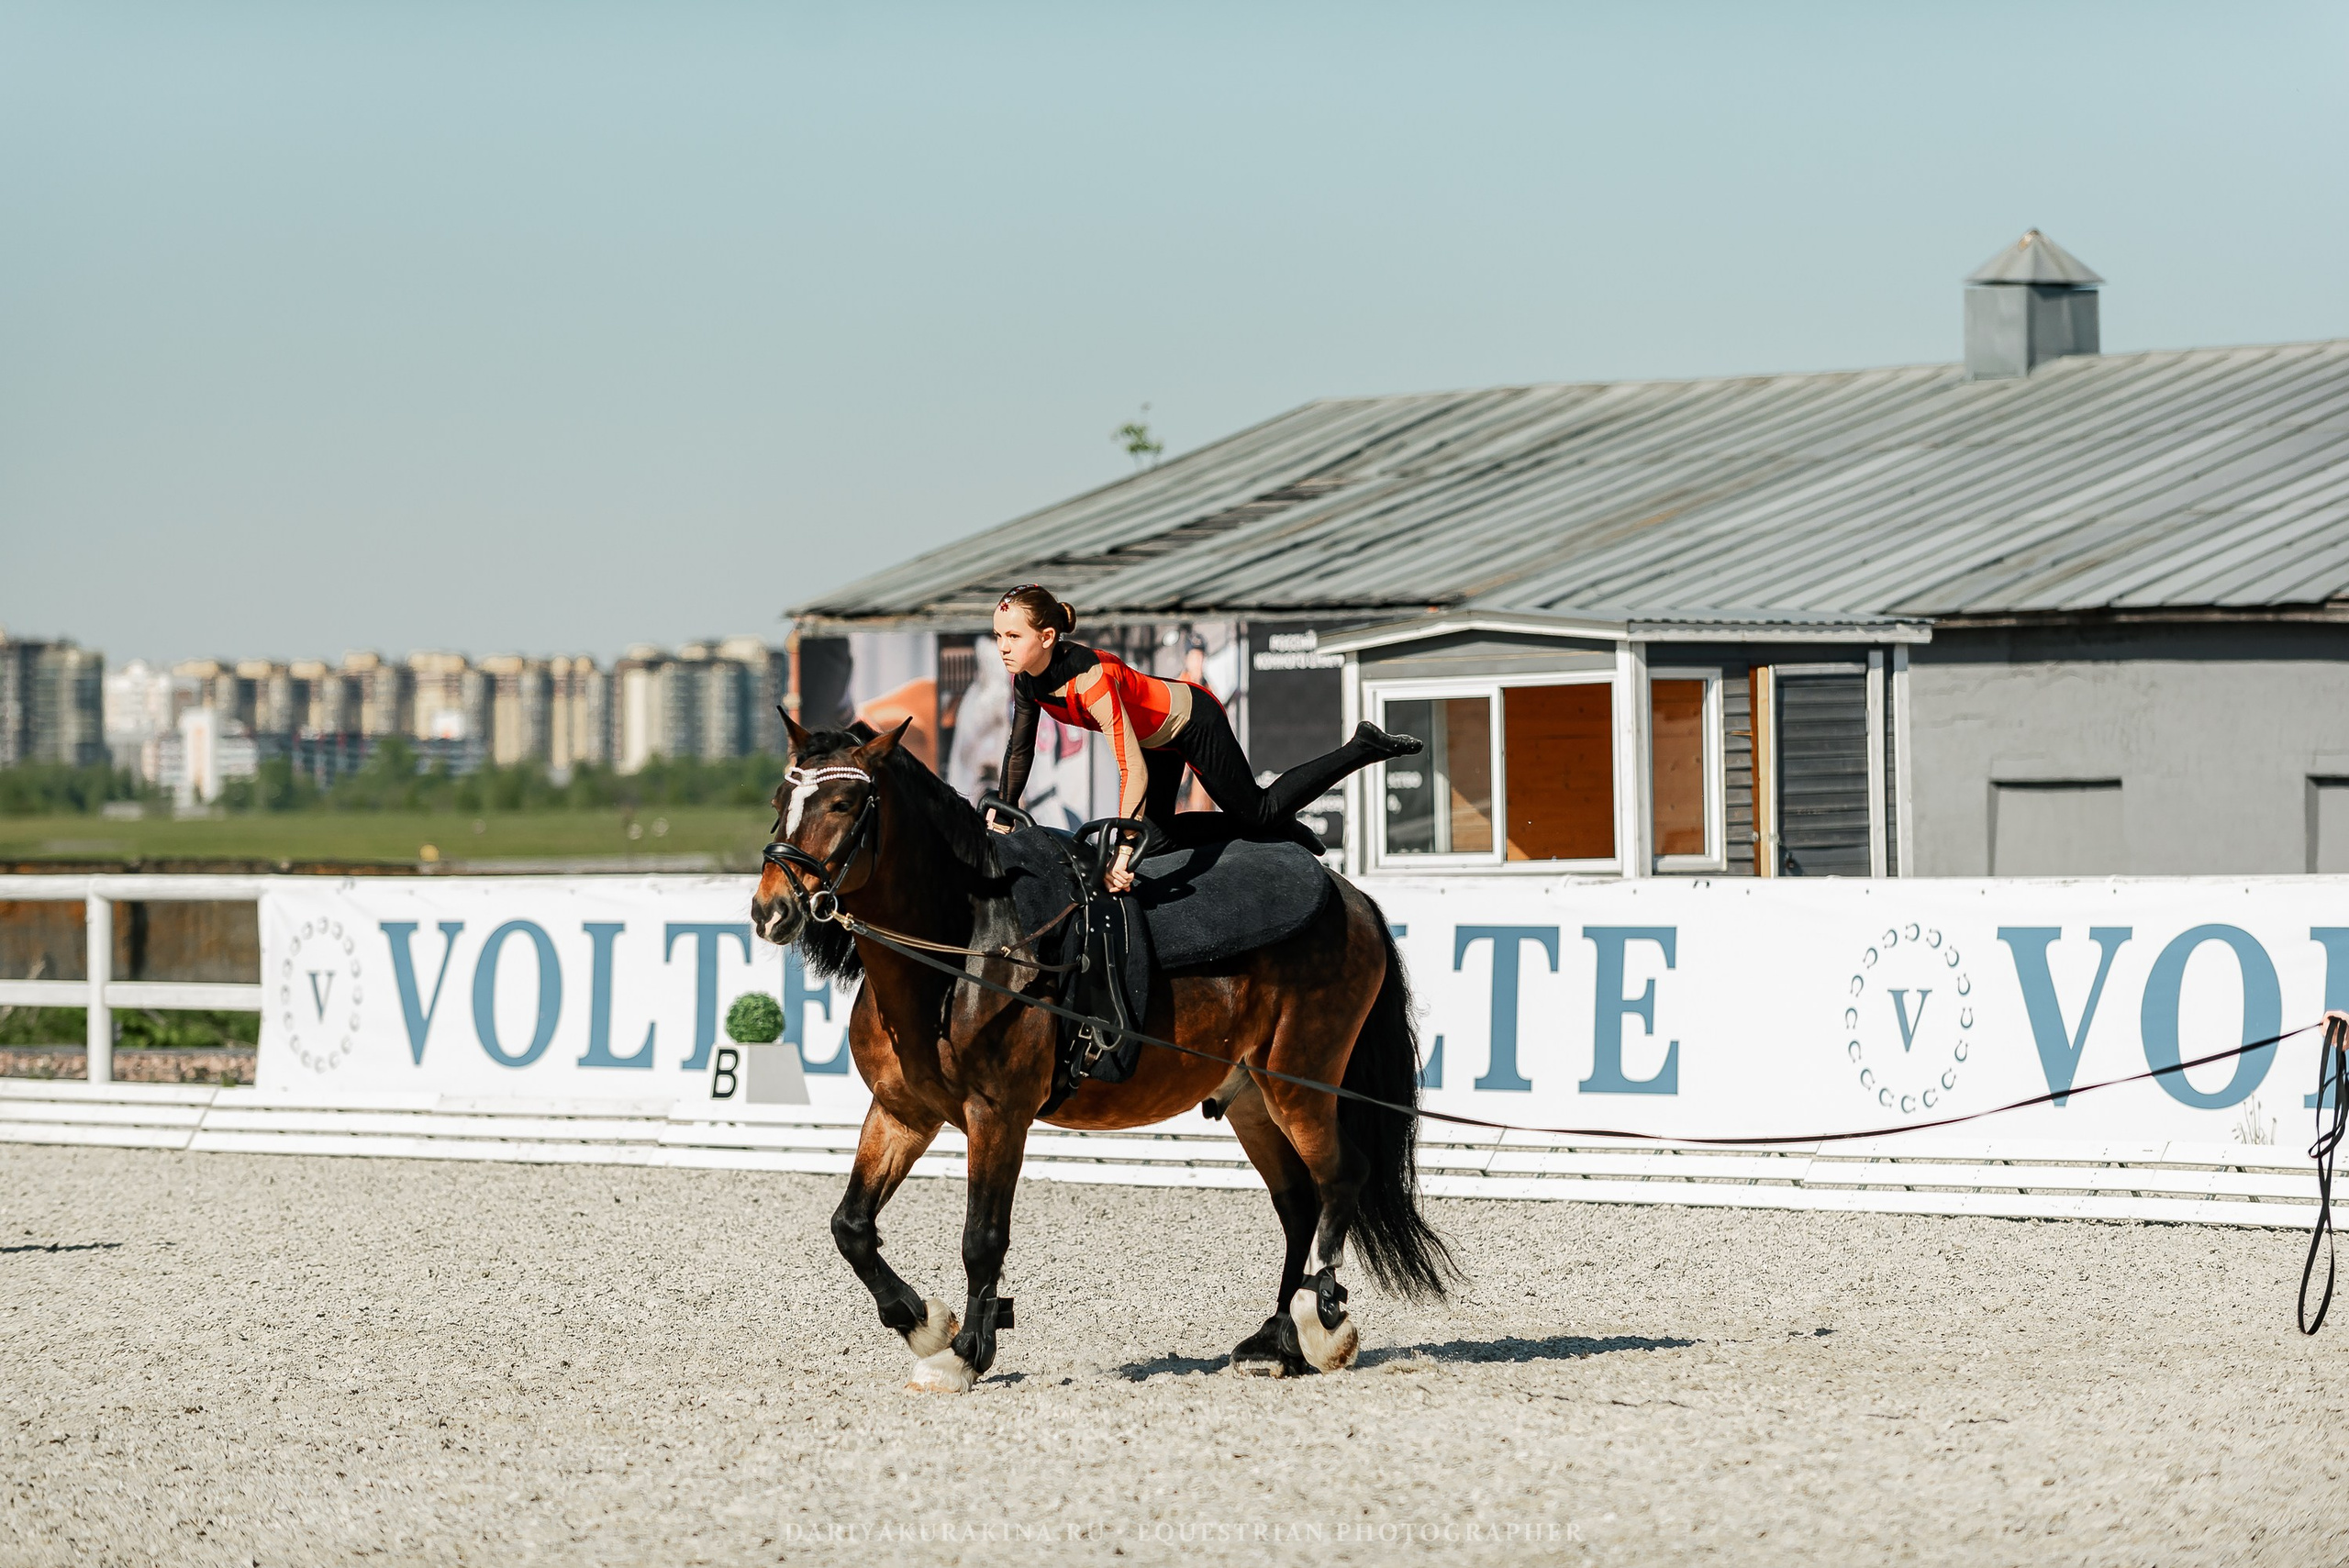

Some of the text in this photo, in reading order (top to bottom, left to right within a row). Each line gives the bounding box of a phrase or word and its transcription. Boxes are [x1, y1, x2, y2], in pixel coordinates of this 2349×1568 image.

[307, 972, 335, 1022] V
[1887, 988, 1932, 1053] V
[711, 1048, 740, 1099] B
